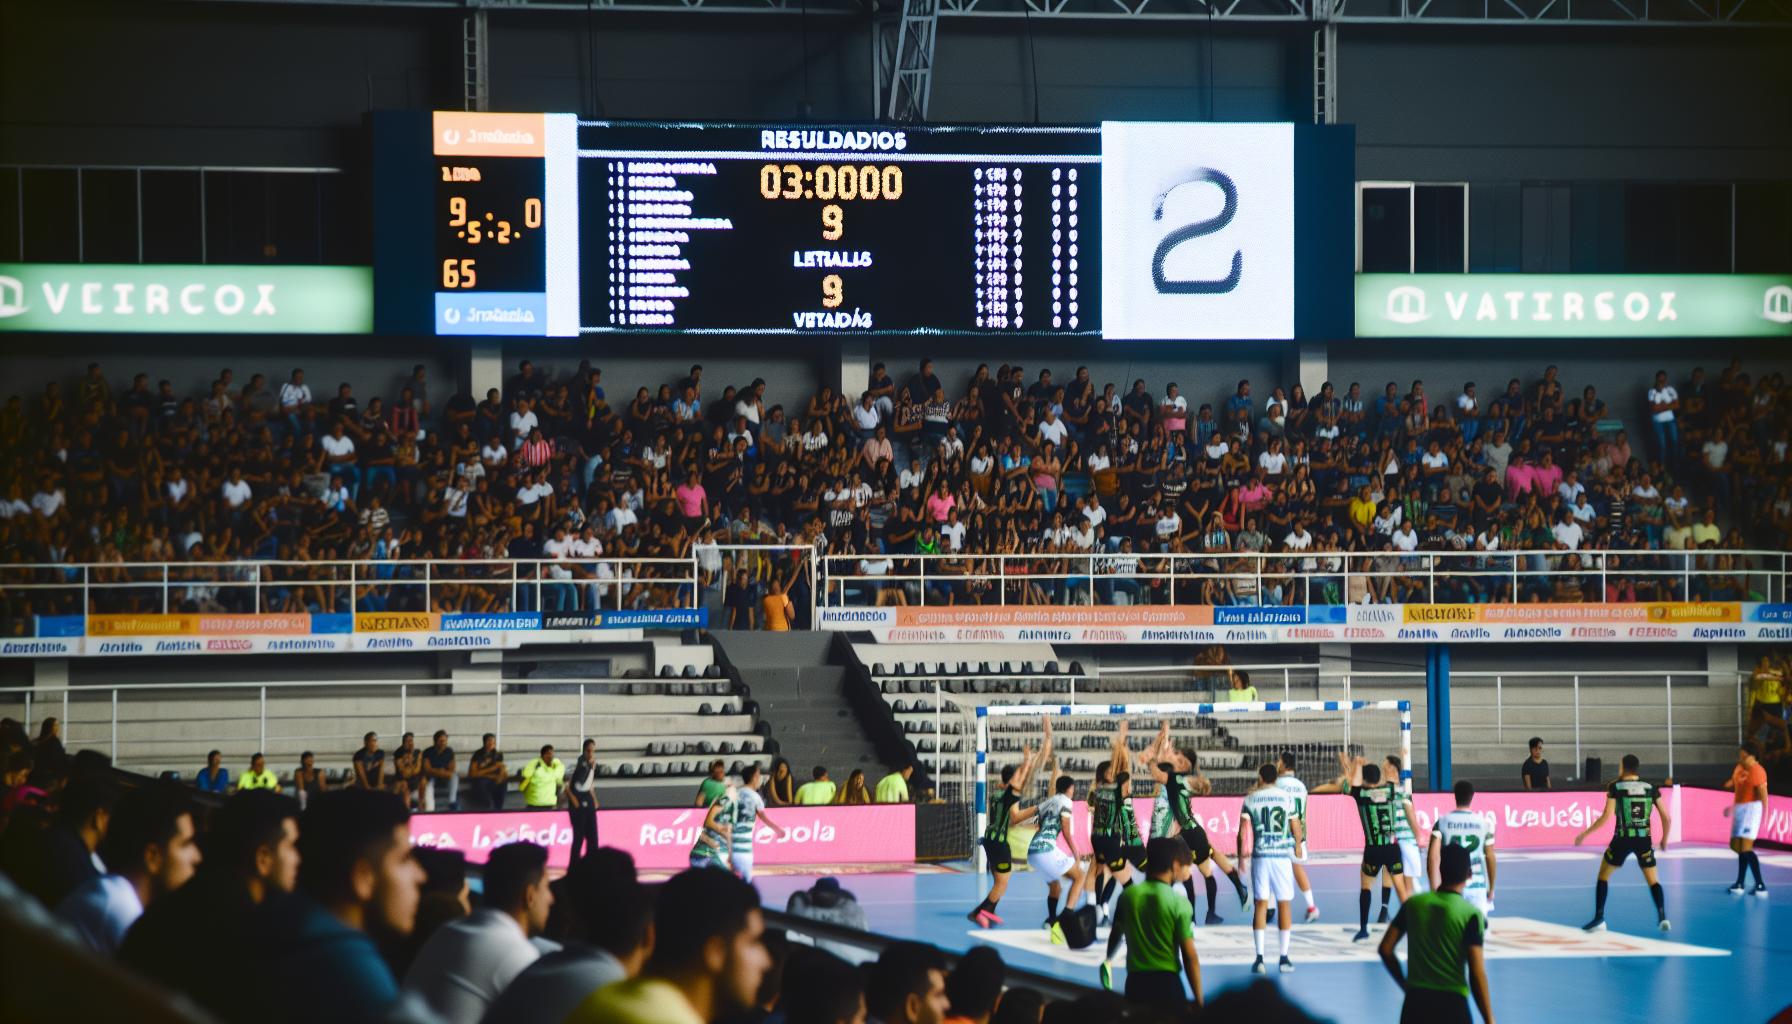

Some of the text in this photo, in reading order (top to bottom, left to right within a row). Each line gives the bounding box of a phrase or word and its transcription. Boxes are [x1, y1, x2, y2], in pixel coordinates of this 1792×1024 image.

[760, 164, 903, 200] 03:0000
[822, 204, 844, 241] 9
[443, 259, 476, 289] 65
[822, 274, 844, 308] 9
